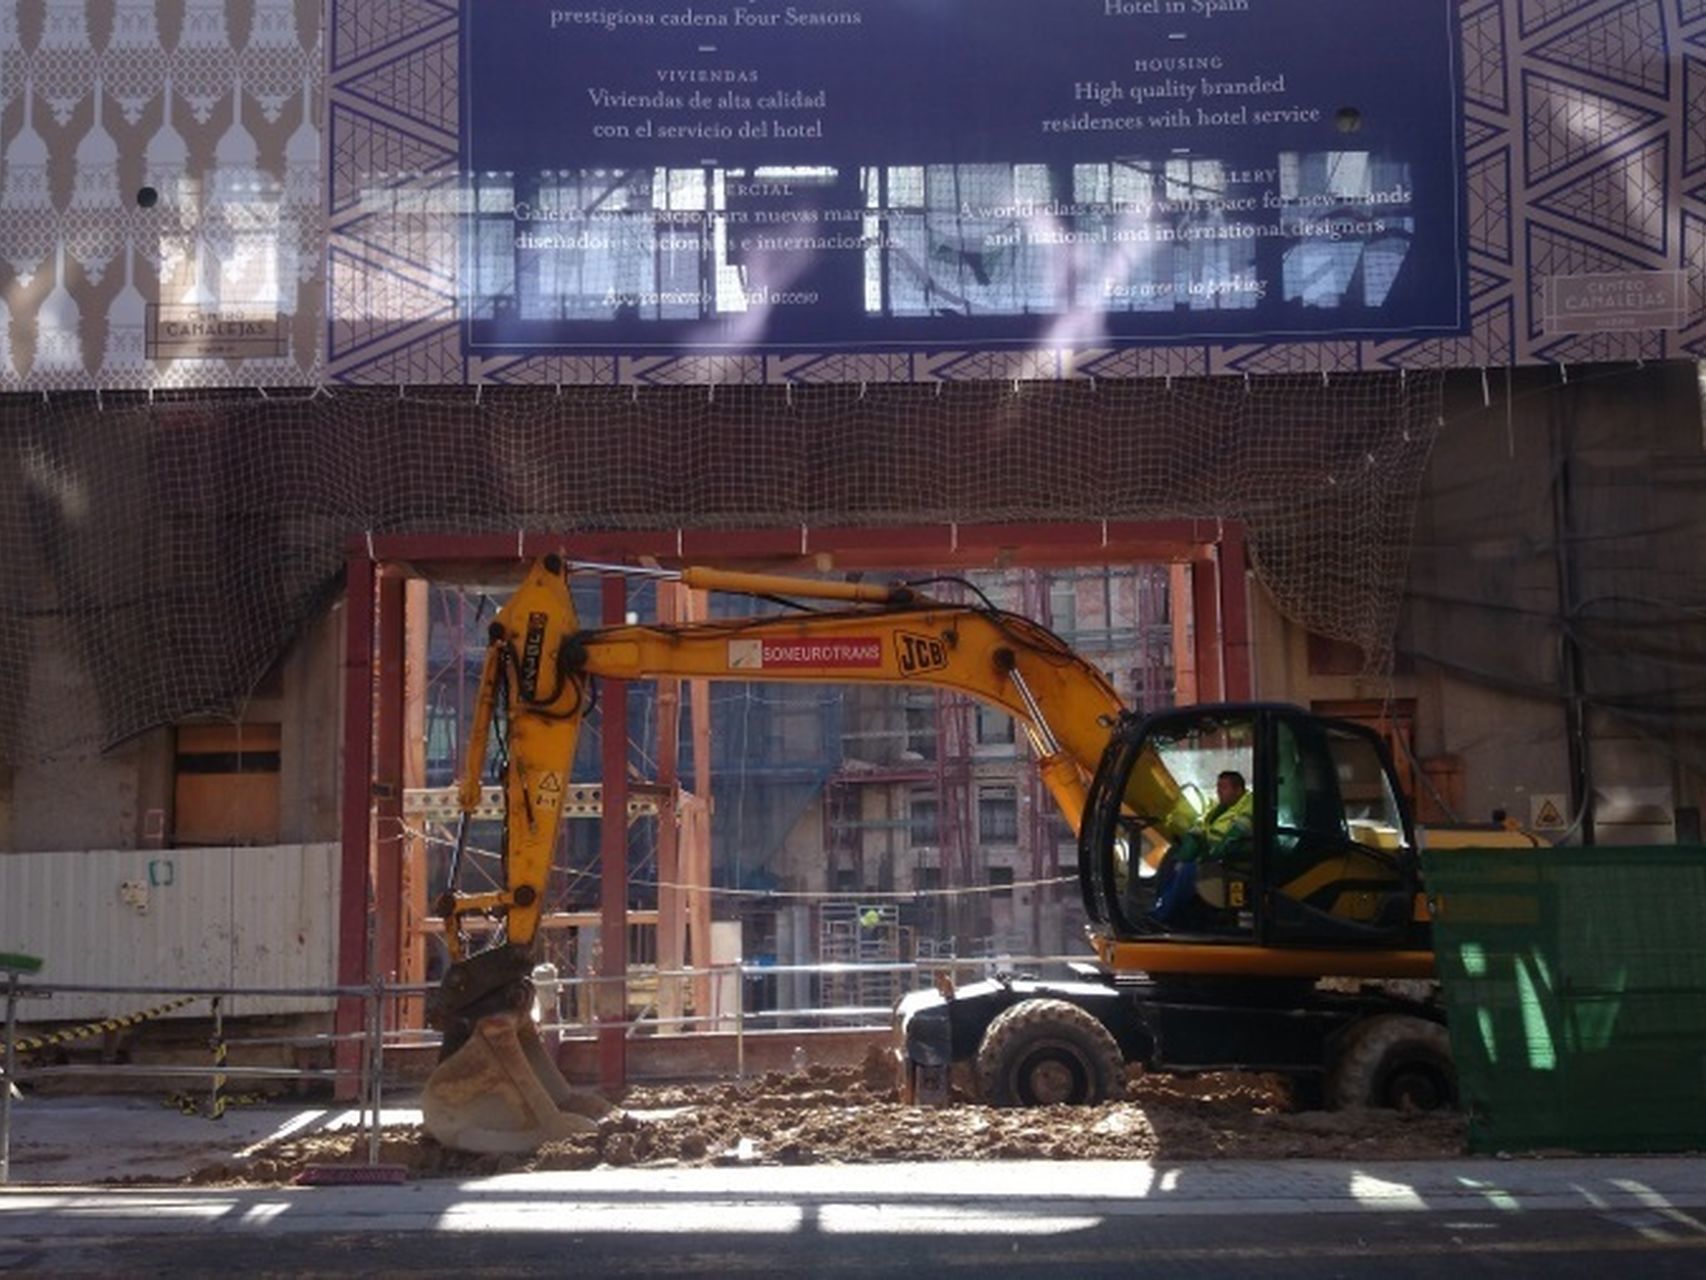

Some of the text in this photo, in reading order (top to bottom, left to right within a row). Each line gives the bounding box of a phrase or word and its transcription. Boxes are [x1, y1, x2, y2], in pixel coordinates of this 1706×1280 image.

[551, 7, 861, 30] prestigiosa cadena Four Seasons
[1104, 0, 1250, 18] Hotel in Spain
[1134, 57, 1224, 72] HOUSING
[657, 70, 759, 83] VIVIENDAS
[588, 88, 826, 109] Viviendas de alta calidad
[1074, 74, 1286, 106] High quality branded
[593, 119, 823, 139] con el servicio del hotel
[1042, 105, 1321, 133] residences with hotel service
[960, 202, 973, 218] A
[1205, 195, 1257, 216] space
[1263, 190, 1292, 208] for
[1299, 195, 1335, 207] new
[754, 210, 818, 223] nuevas
[984, 223, 1021, 247] and
[1112, 222, 1150, 242] and
[1156, 220, 1284, 243] international
[1292, 217, 1386, 240] designers
[741, 240, 751, 250] e
[901, 634, 945, 672] JCB
